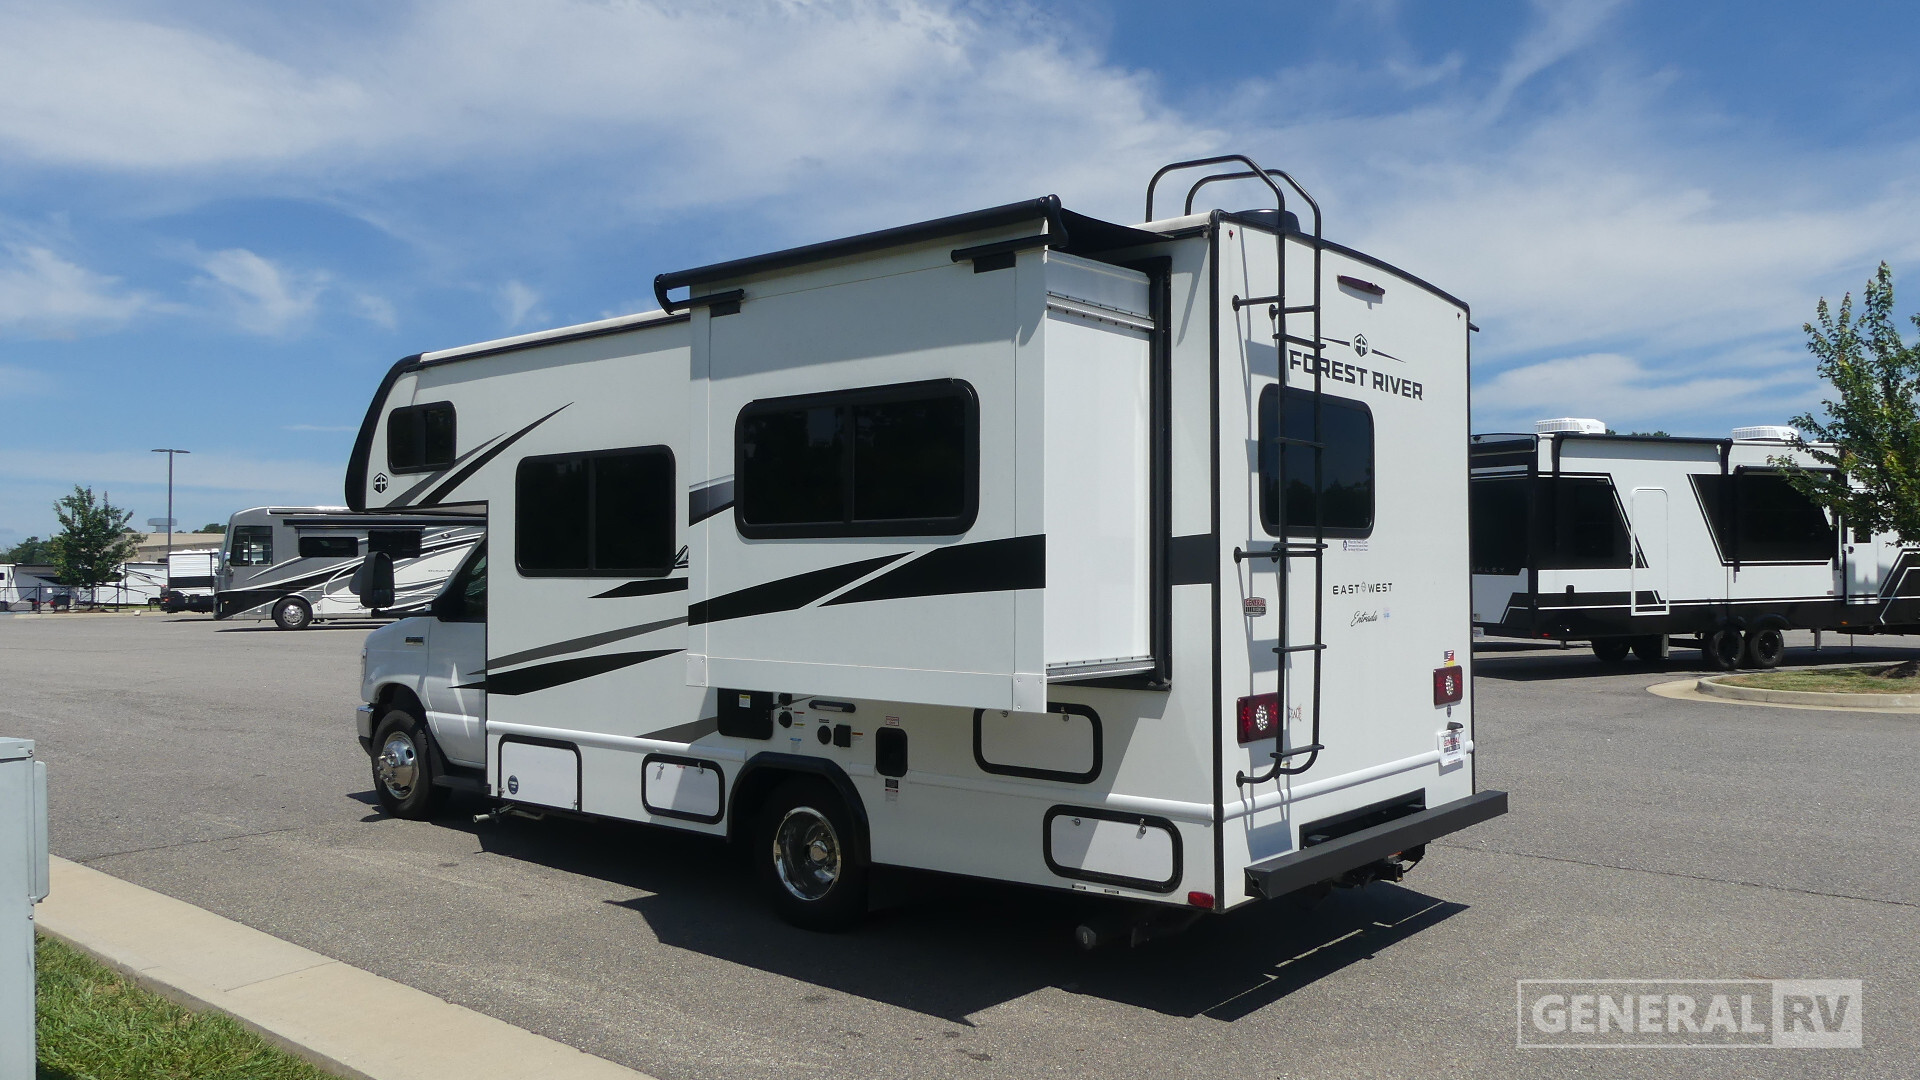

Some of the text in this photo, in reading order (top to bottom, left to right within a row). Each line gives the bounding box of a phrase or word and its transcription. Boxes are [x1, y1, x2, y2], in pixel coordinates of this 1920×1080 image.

[1288, 349, 1423, 400] FOREST RIVER
[1332, 582, 1393, 595] EAST WEST
[1350, 610, 1378, 627] Entrada
